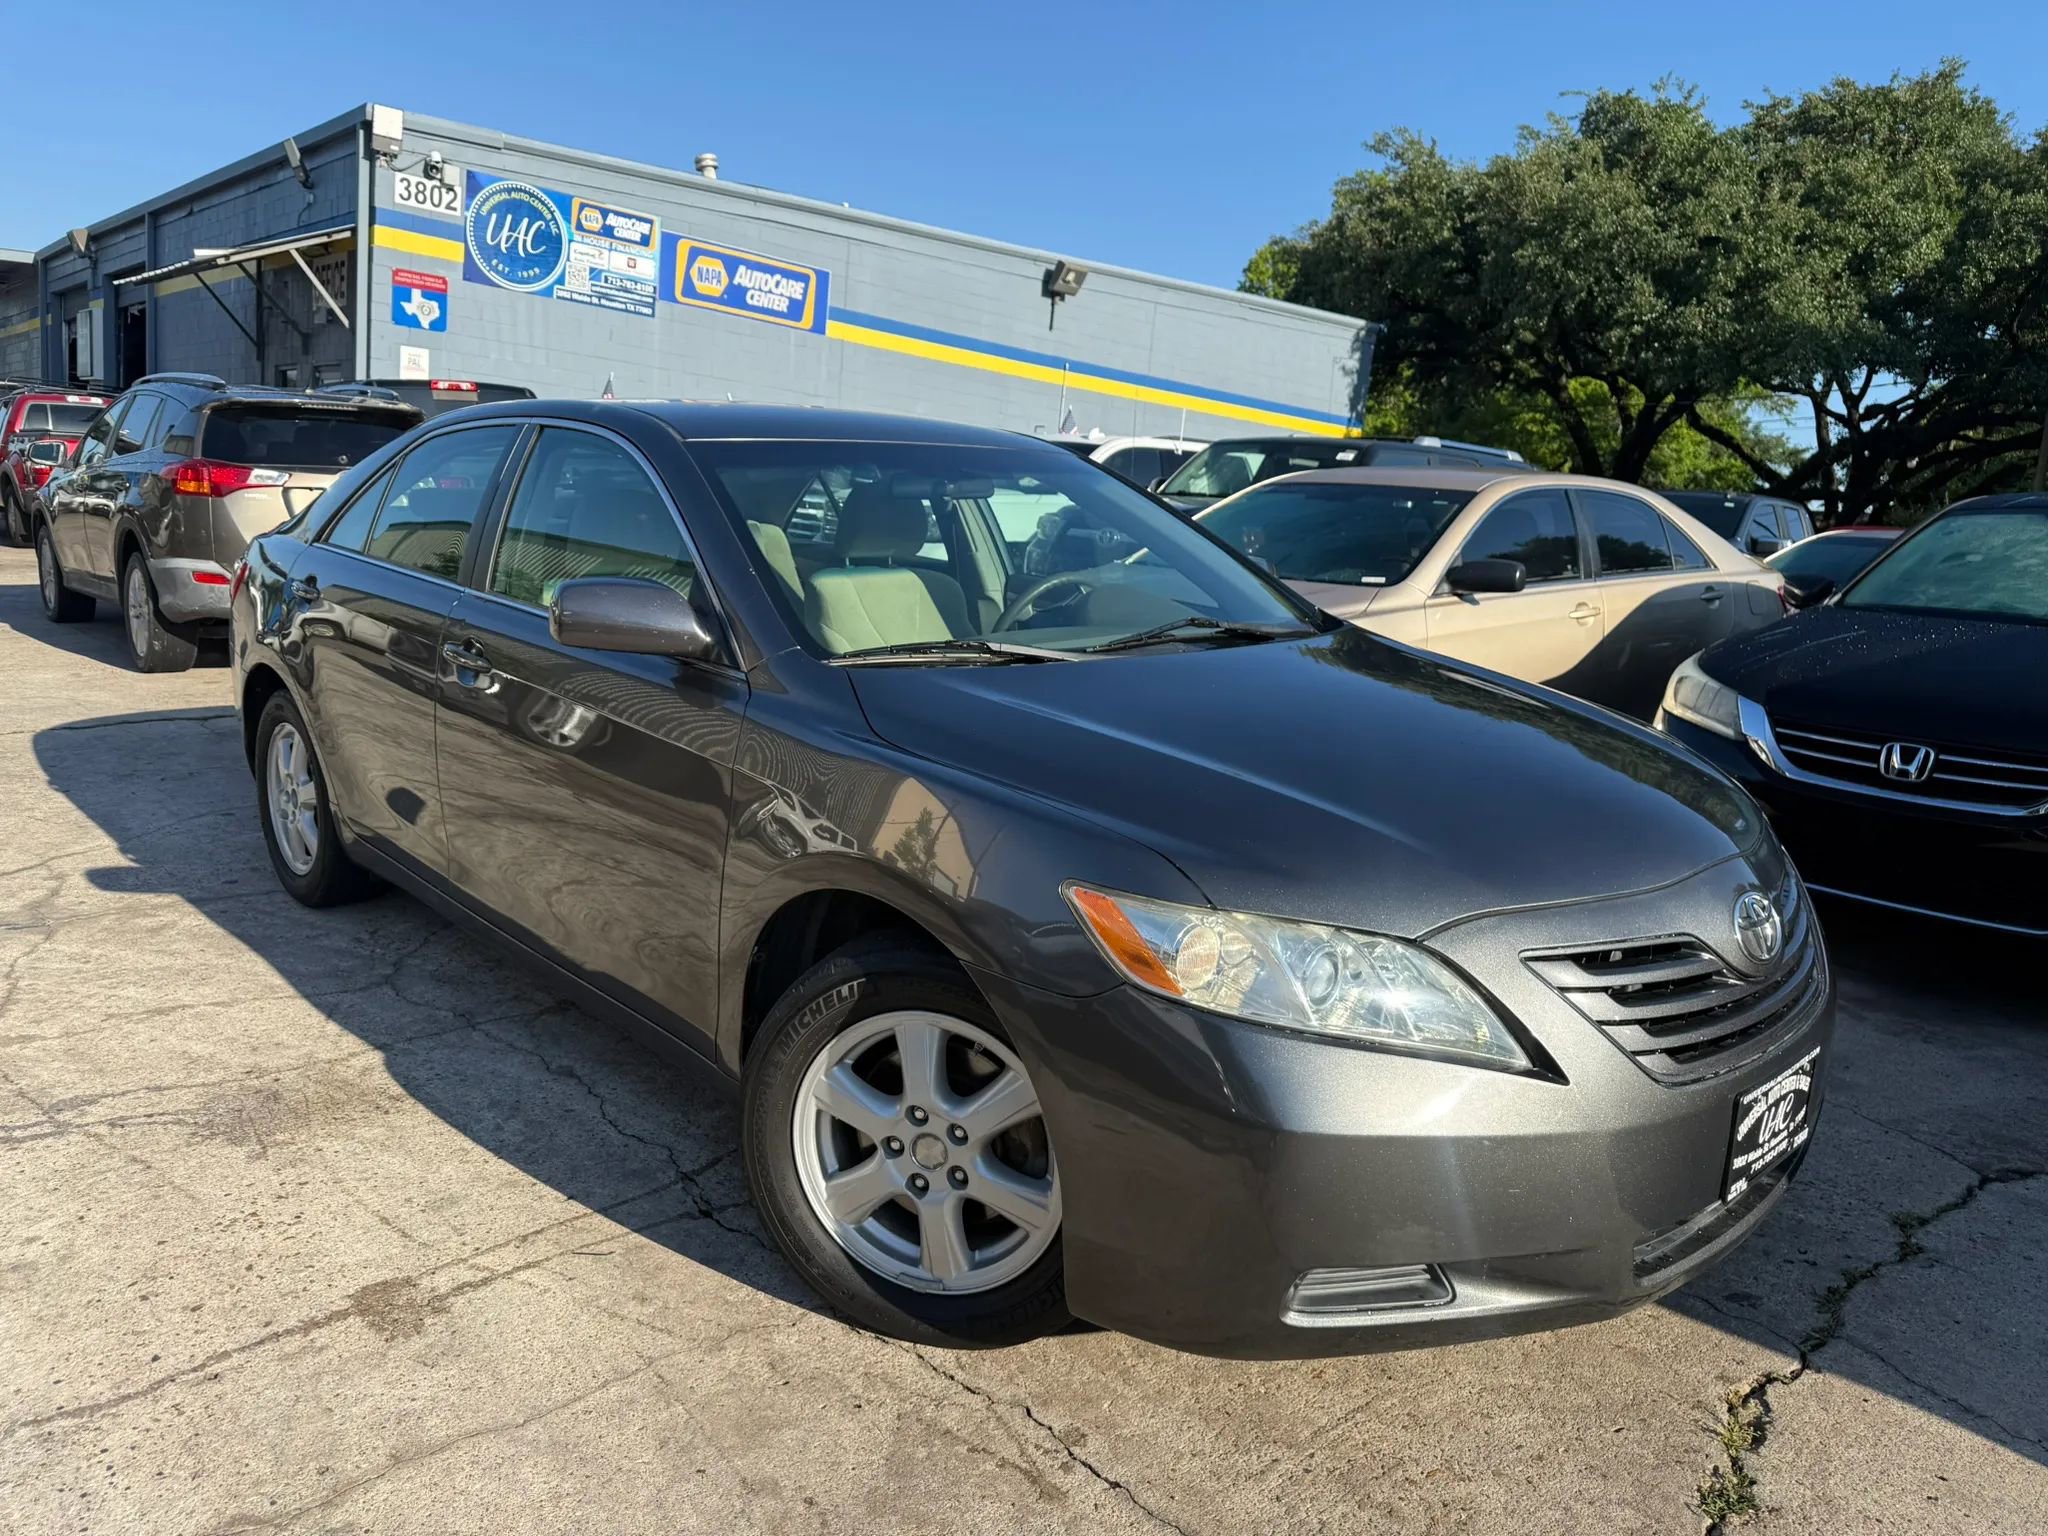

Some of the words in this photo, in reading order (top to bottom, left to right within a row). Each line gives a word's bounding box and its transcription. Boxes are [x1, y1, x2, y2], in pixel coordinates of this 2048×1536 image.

[398, 177, 458, 212] 3802
[480, 191, 510, 215] UNIVERSAL
[511, 191, 530, 202] AUTO
[530, 197, 553, 221] CENTER
[486, 213, 547, 258] UAC
[697, 266, 723, 287] NAPA
[745, 288, 790, 313] CENTER
